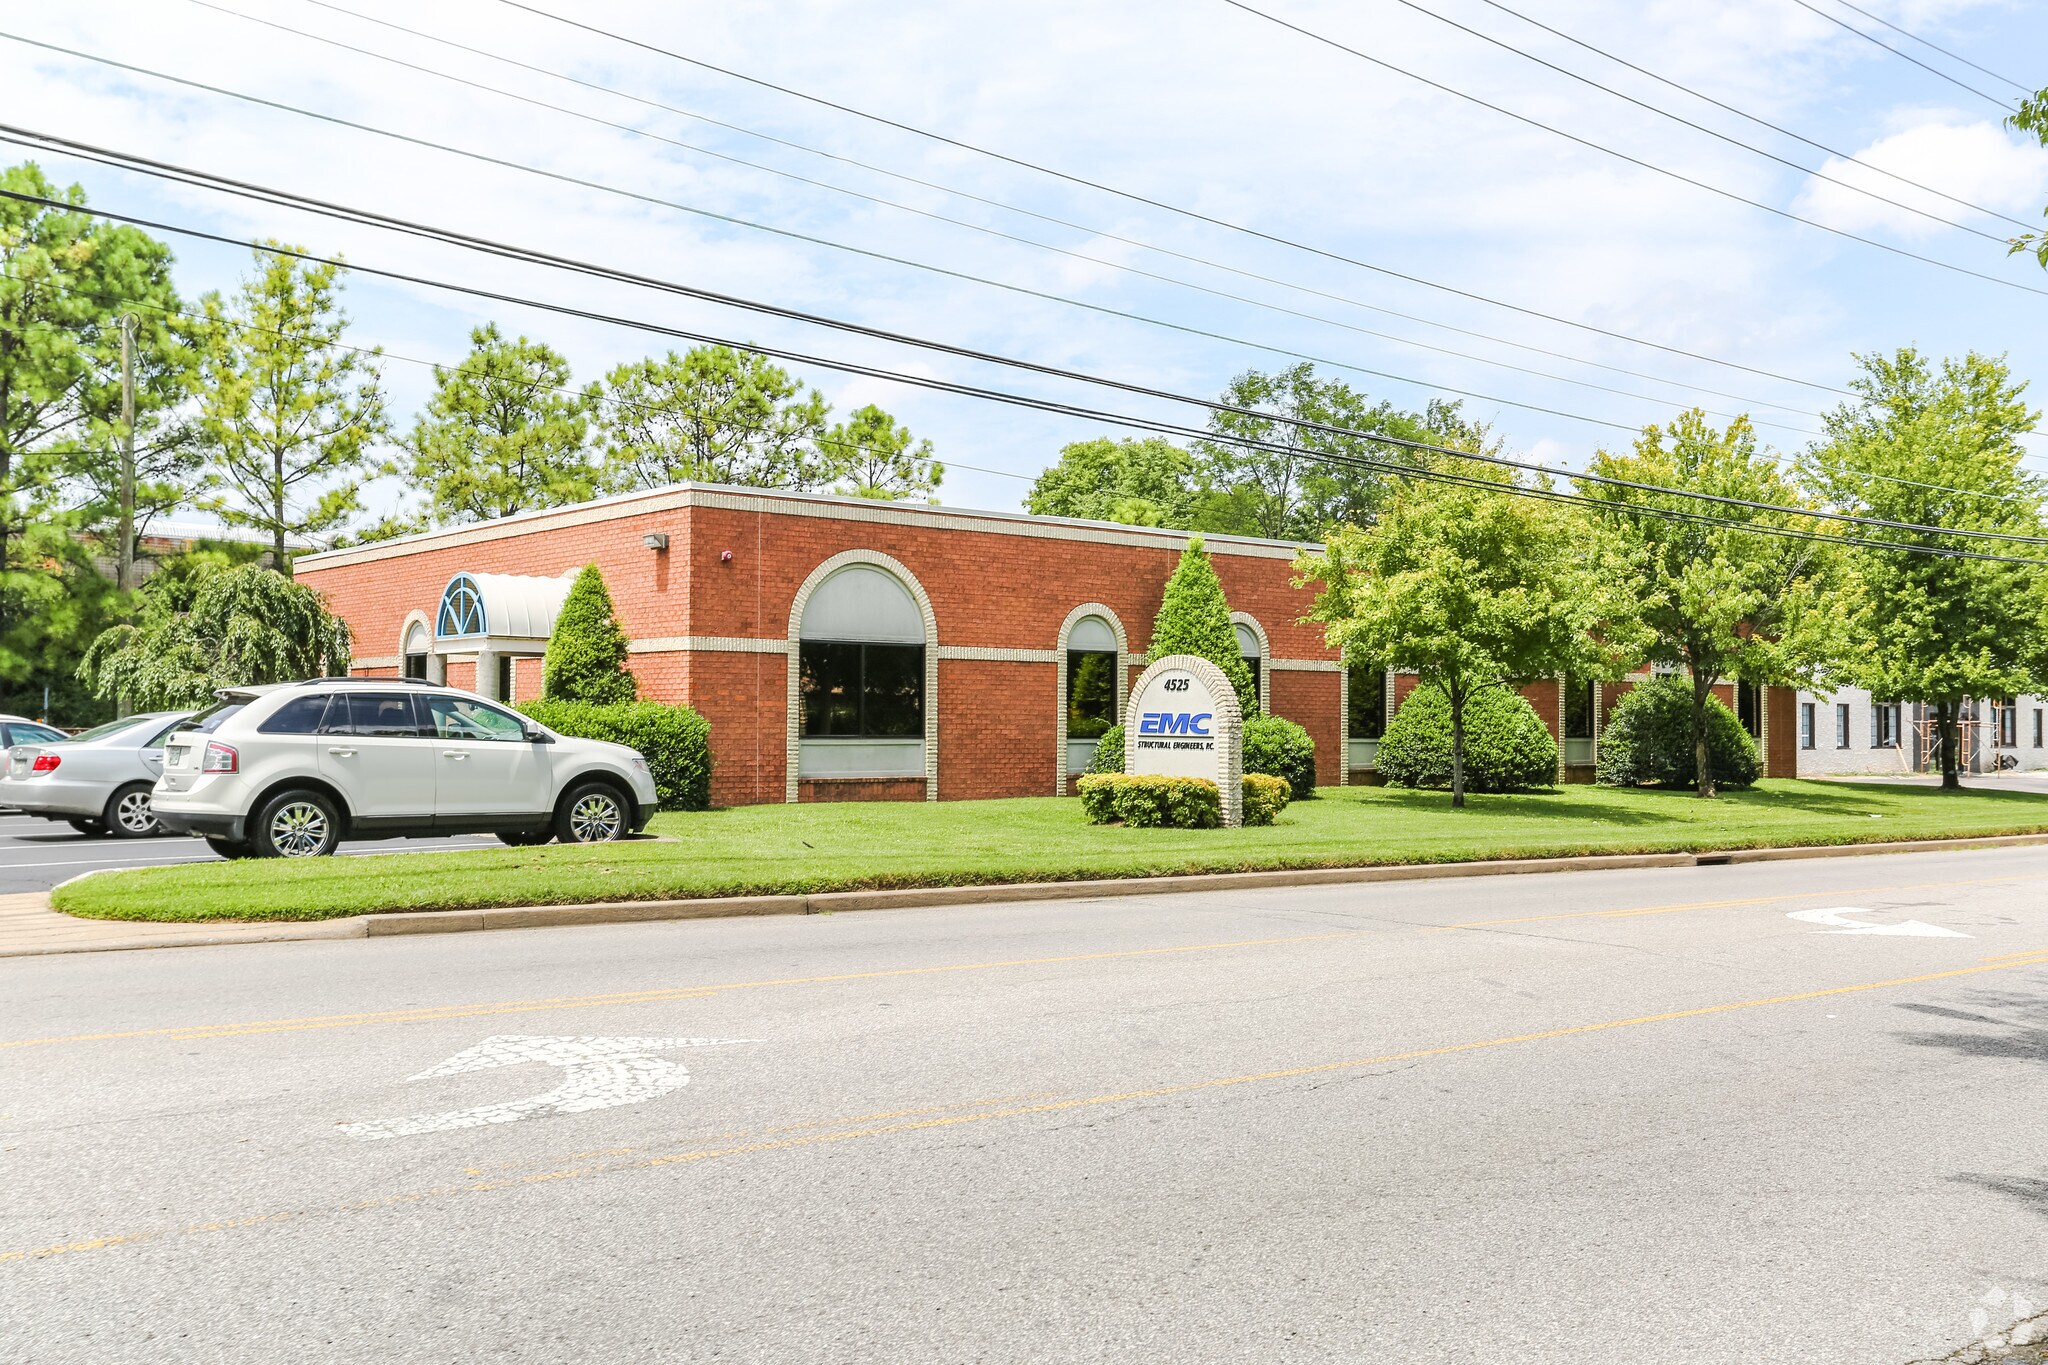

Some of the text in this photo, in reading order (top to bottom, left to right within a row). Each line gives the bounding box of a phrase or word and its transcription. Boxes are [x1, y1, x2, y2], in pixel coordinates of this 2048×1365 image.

[1164, 679, 1190, 691] 4525
[1140, 713, 1212, 734] EMC
[1138, 740, 1171, 750] STRUCTURAL
[1173, 741, 1204, 751] ENGINEERS,
